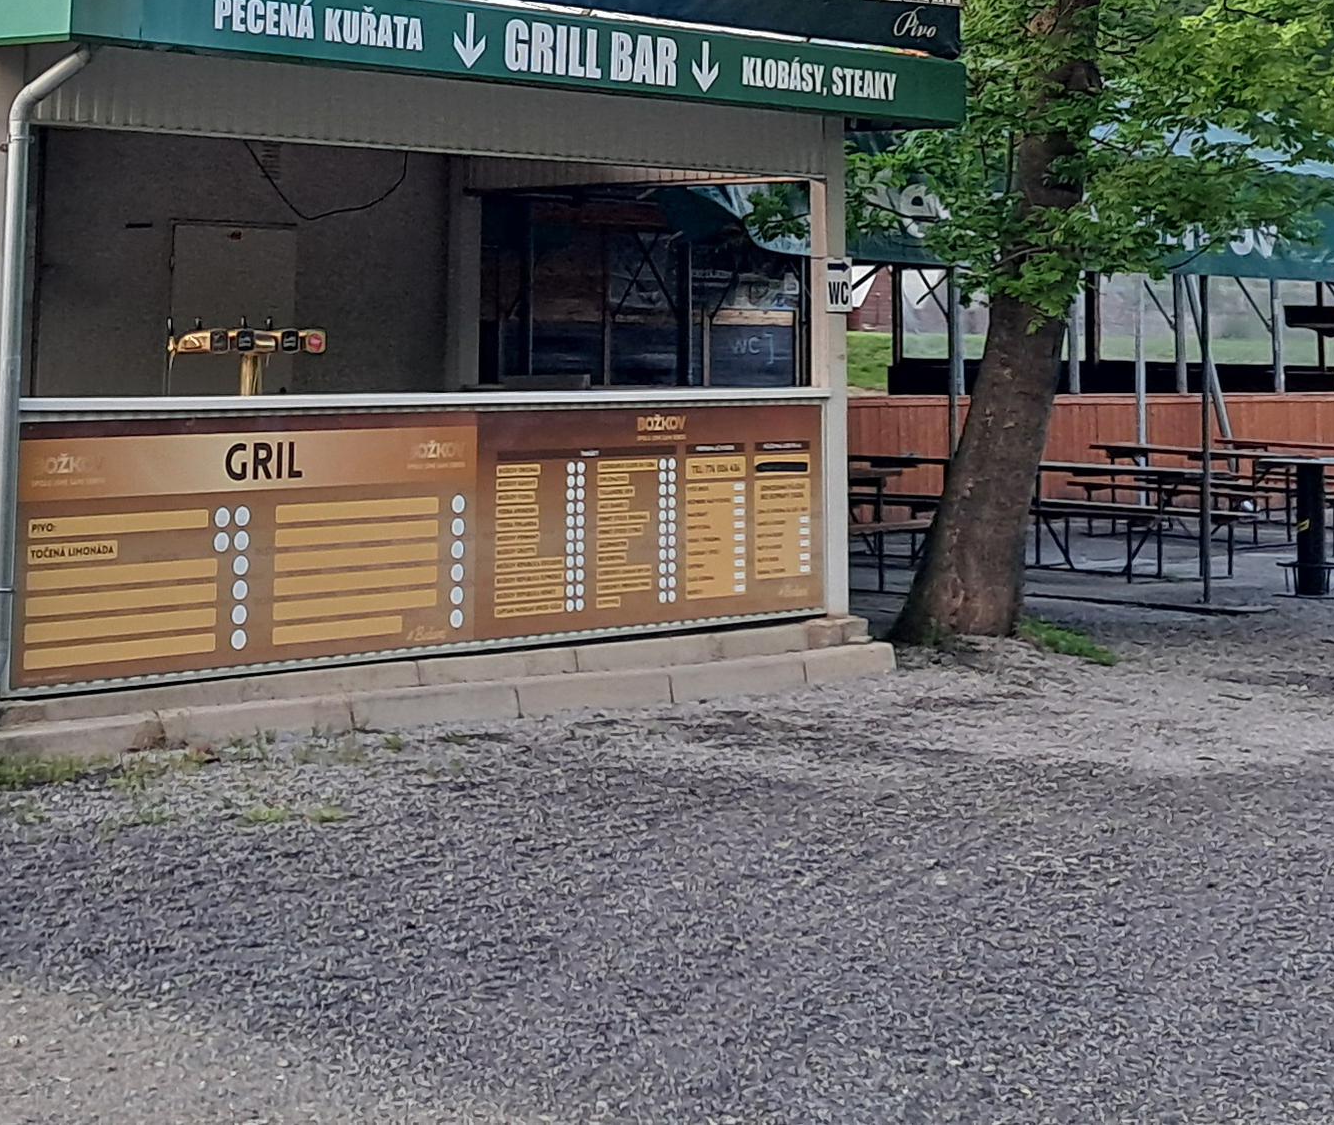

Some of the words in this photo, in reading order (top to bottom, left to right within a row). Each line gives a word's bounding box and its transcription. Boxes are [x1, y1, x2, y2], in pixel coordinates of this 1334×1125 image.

[324, 5, 423, 52] KUŘATA
[893, 6, 936, 38] Pivo
[504, 19, 601, 79] GRILL
[610, 29, 678, 87] BAR
[741, 56, 828, 97] KLOBÁSY,
[832, 66, 897, 101] STEAKY
[828, 280, 849, 305] WC
[636, 413, 687, 431] BOŽKOV
[225, 441, 303, 481] GRIL
[30, 547, 65, 559] TOČENÁ
[68, 545, 114, 557] LIMONÁDA
